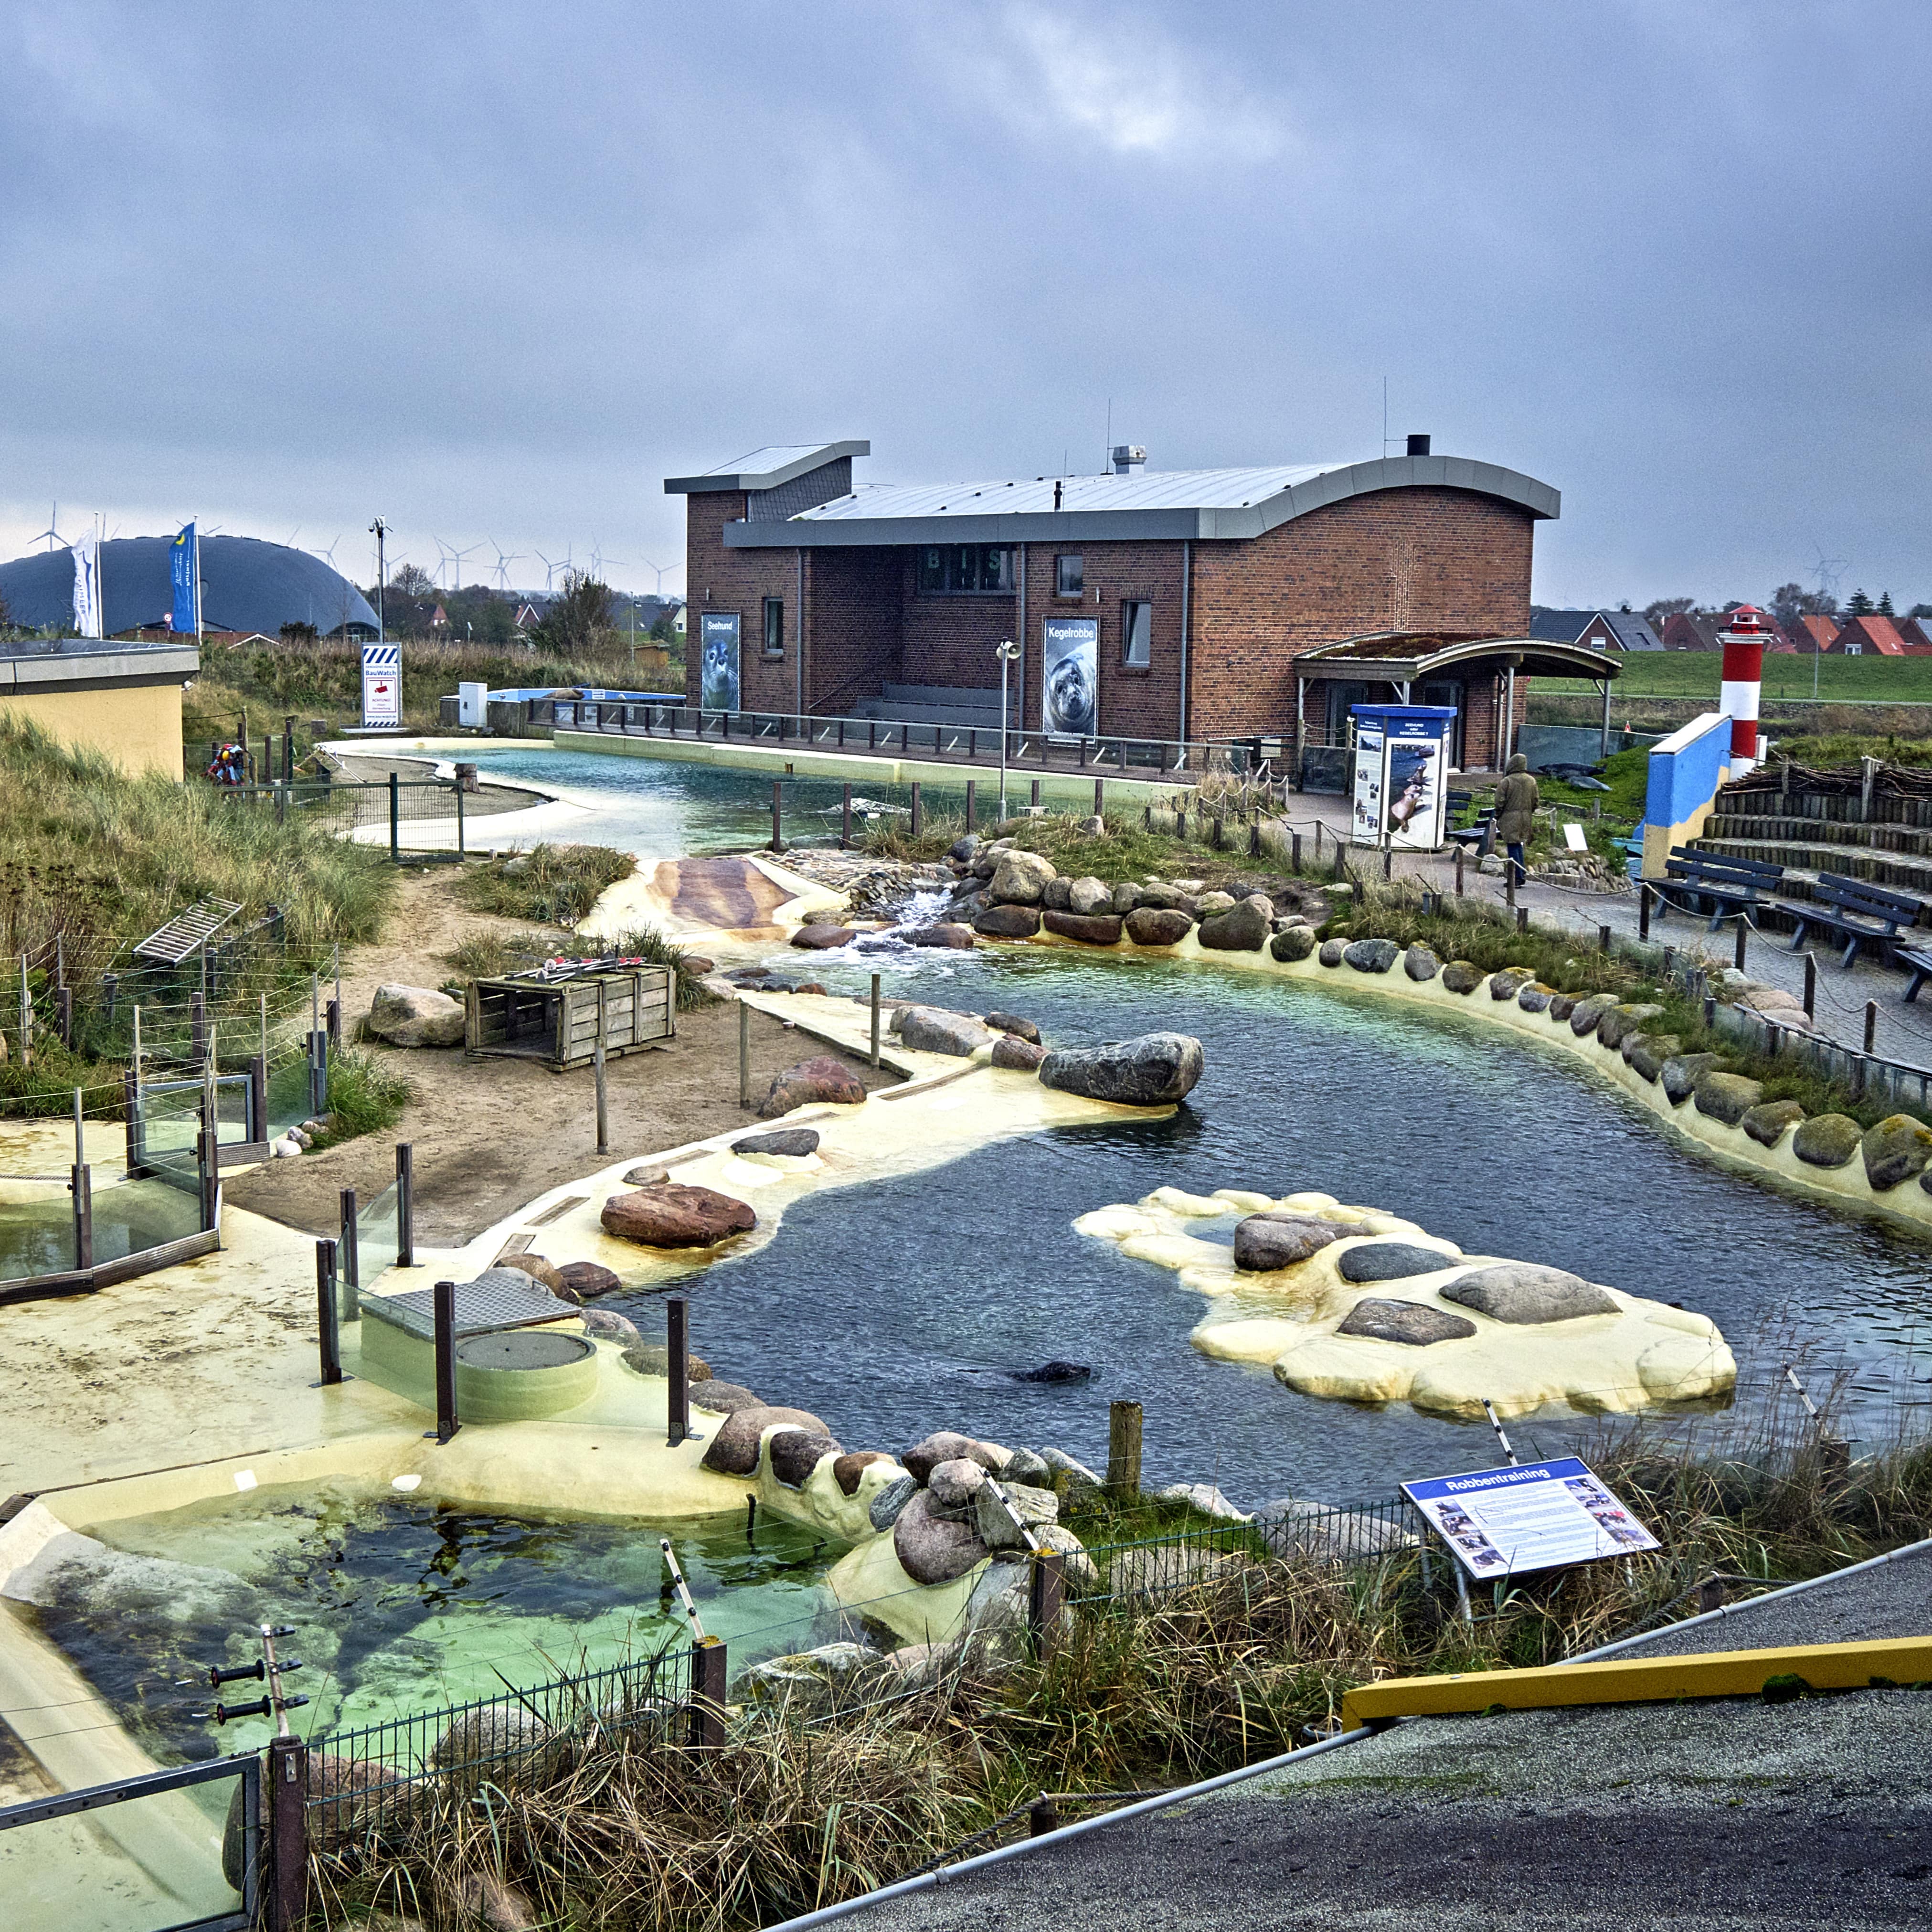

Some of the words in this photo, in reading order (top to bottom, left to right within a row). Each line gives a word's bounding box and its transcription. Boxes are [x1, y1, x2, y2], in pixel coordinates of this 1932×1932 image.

[707, 621, 732, 630] Seehund
[1049, 627, 1094, 640] Kegelrobbe
[1445, 1469, 1550, 1490] Robbentraining
